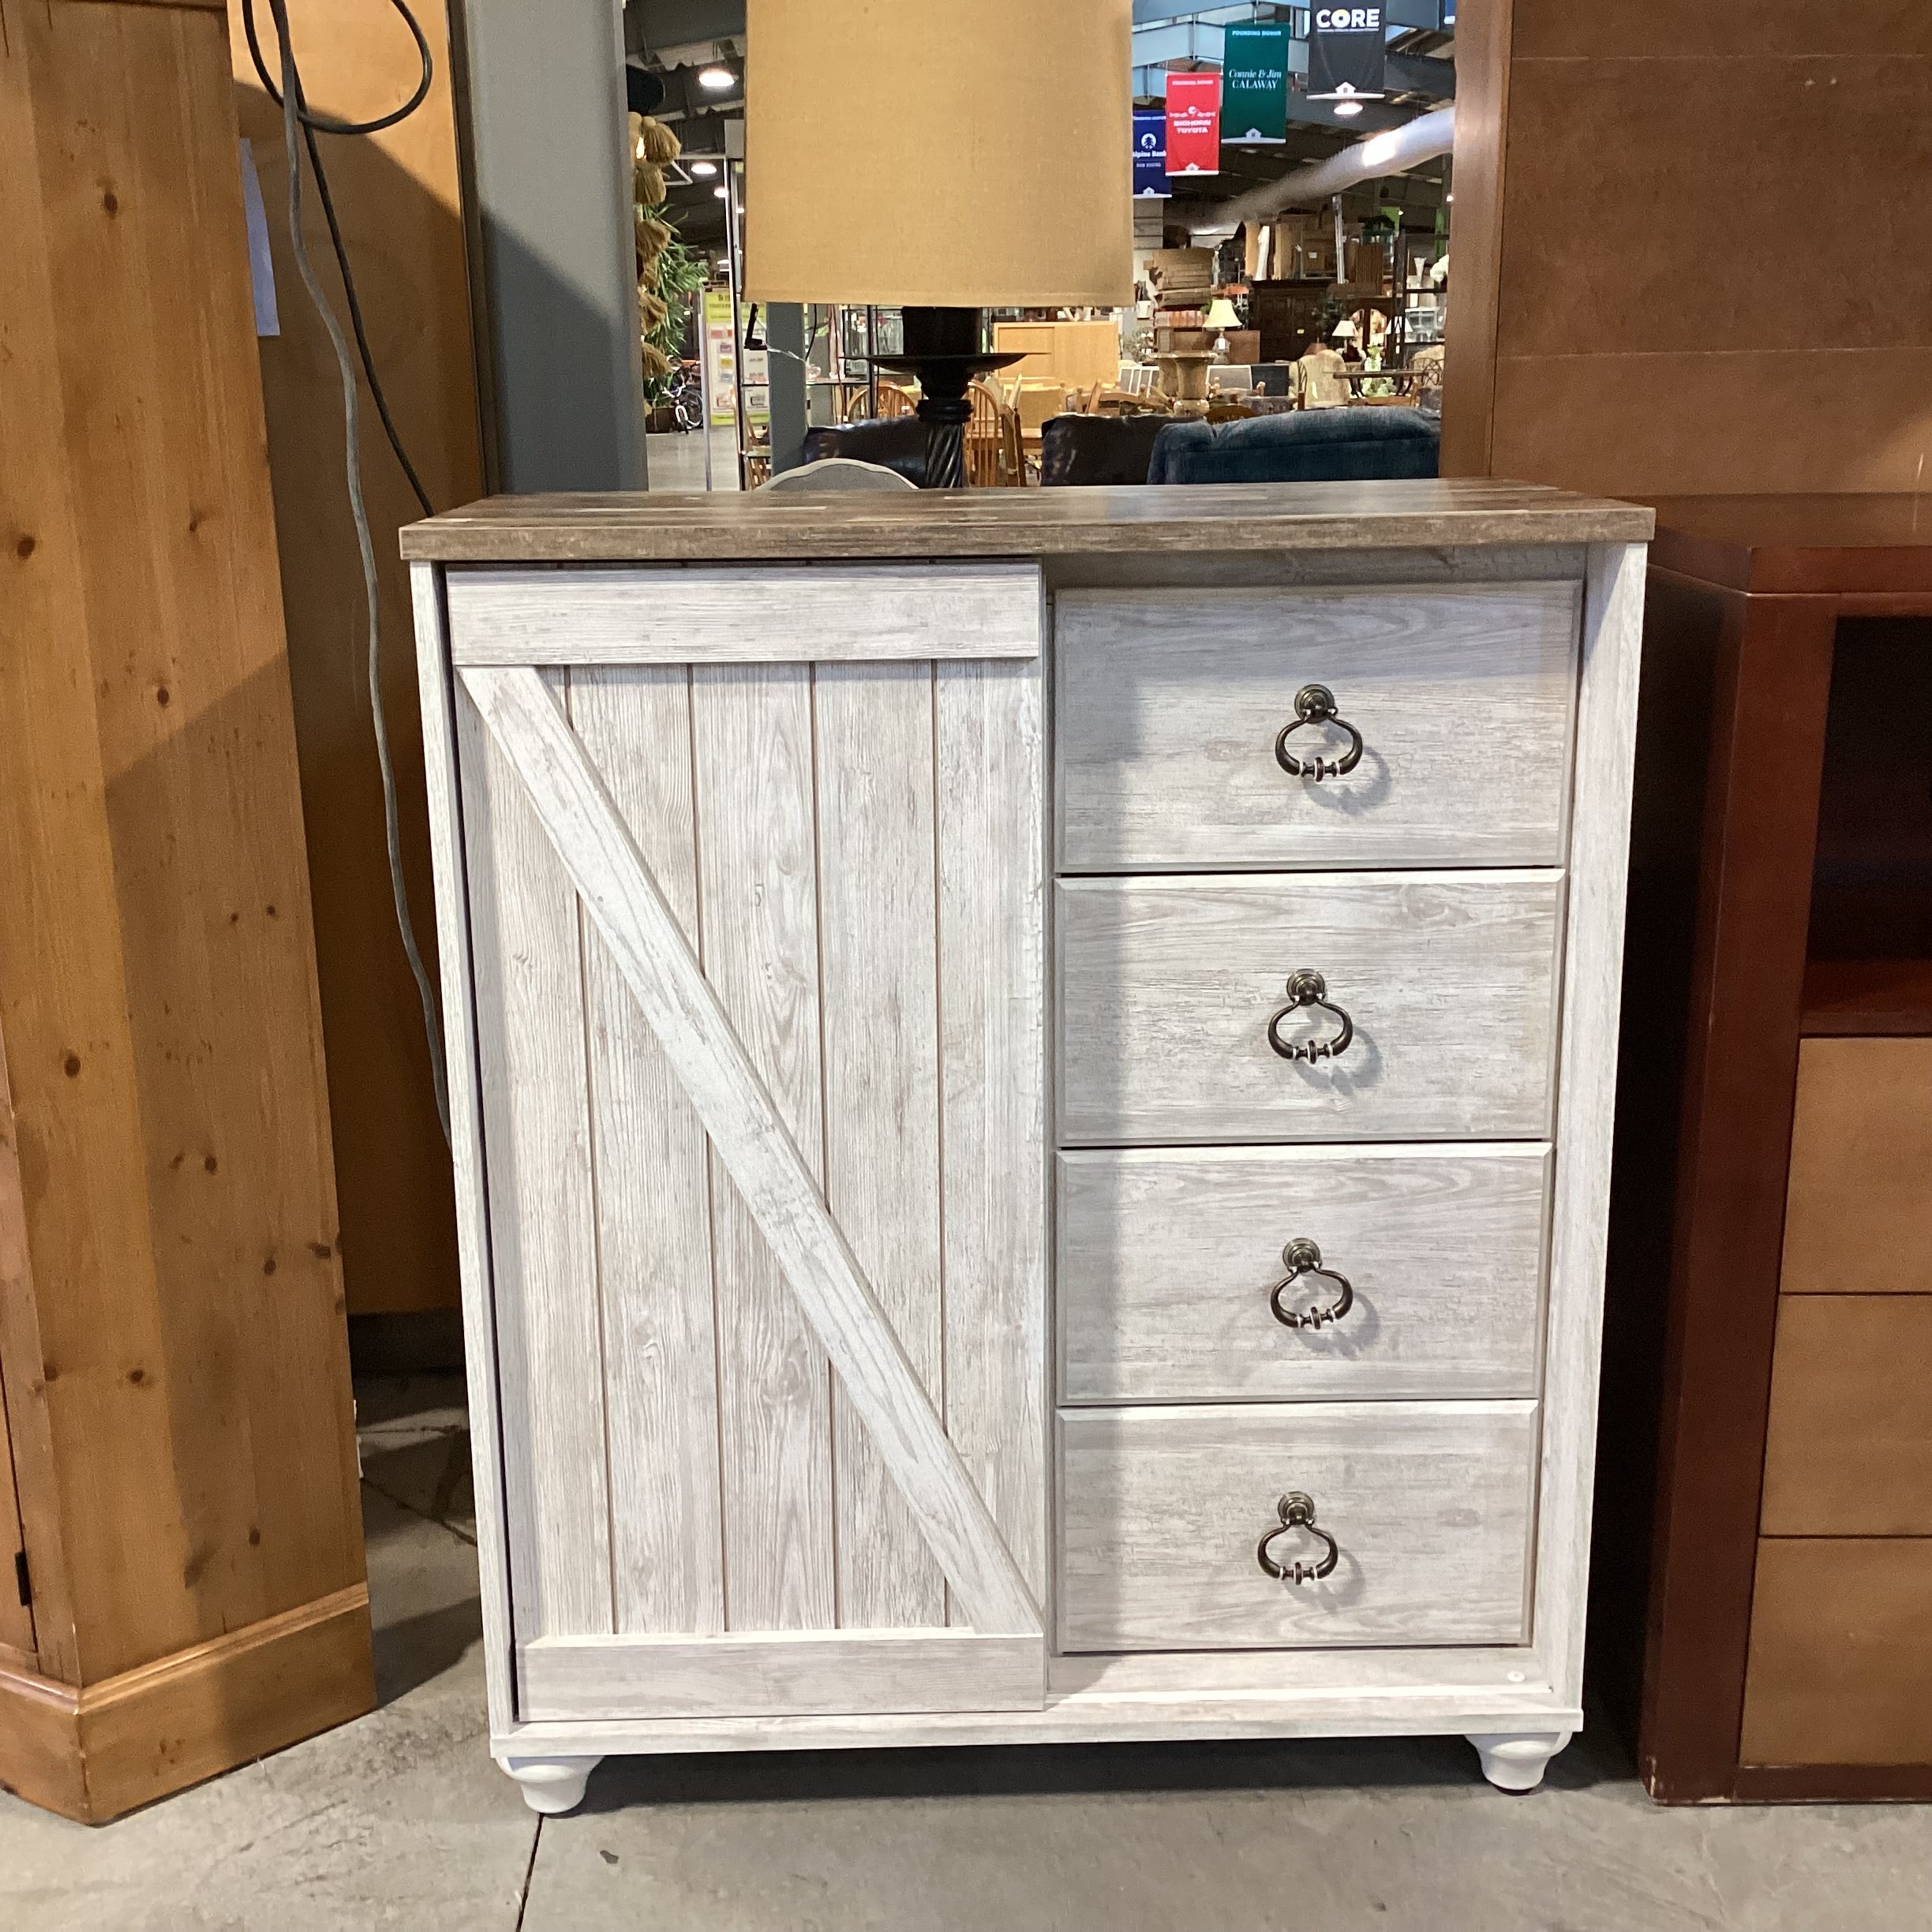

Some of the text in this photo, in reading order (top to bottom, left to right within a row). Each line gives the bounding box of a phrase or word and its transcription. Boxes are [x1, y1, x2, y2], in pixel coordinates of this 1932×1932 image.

[1316, 9, 1380, 28] CORE
[1229, 69, 1282, 78] Connie & Jim
[1232, 80, 1278, 89] CALAWAY
